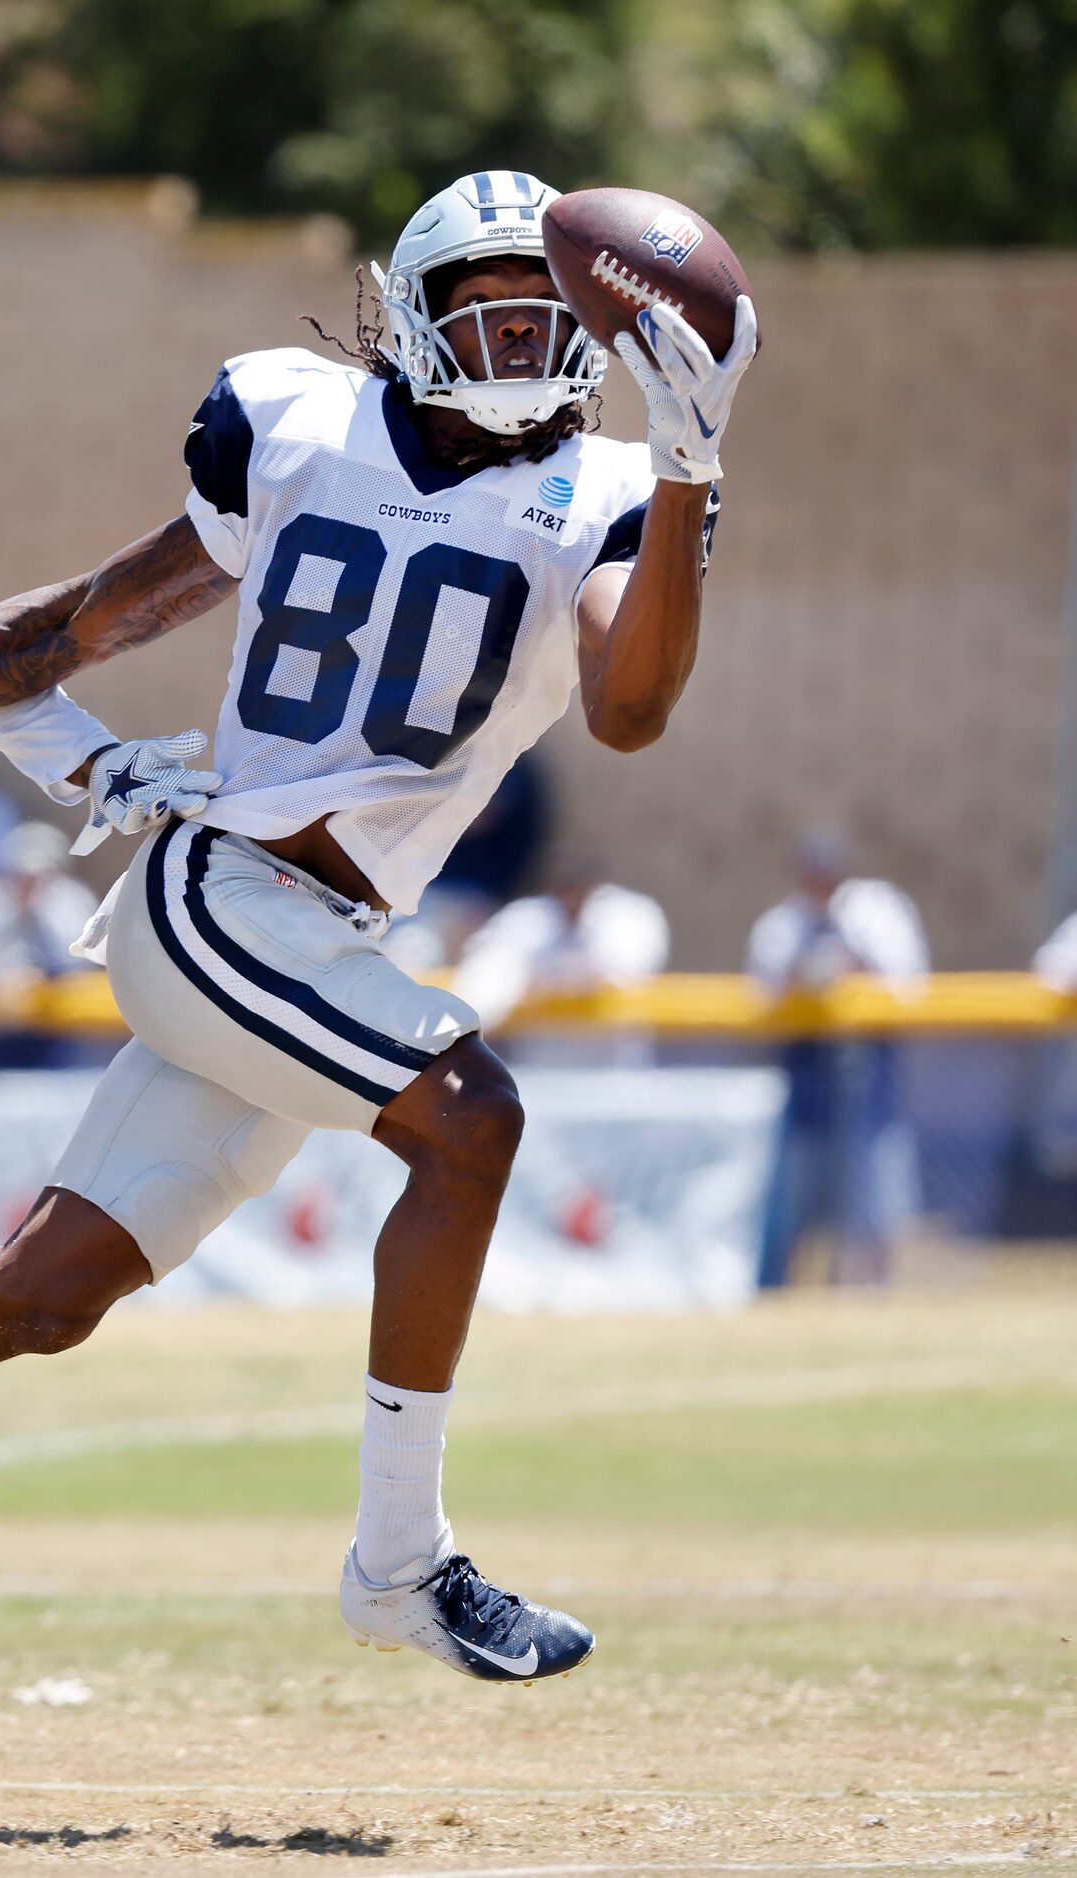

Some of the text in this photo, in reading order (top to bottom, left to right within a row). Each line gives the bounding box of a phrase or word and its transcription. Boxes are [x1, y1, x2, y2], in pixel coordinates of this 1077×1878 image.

[487, 226, 533, 236] COWBOYS
[378, 503, 452, 524] COWBOYS
[521, 507, 567, 532] AT&T
[237, 512, 530, 770] 80
